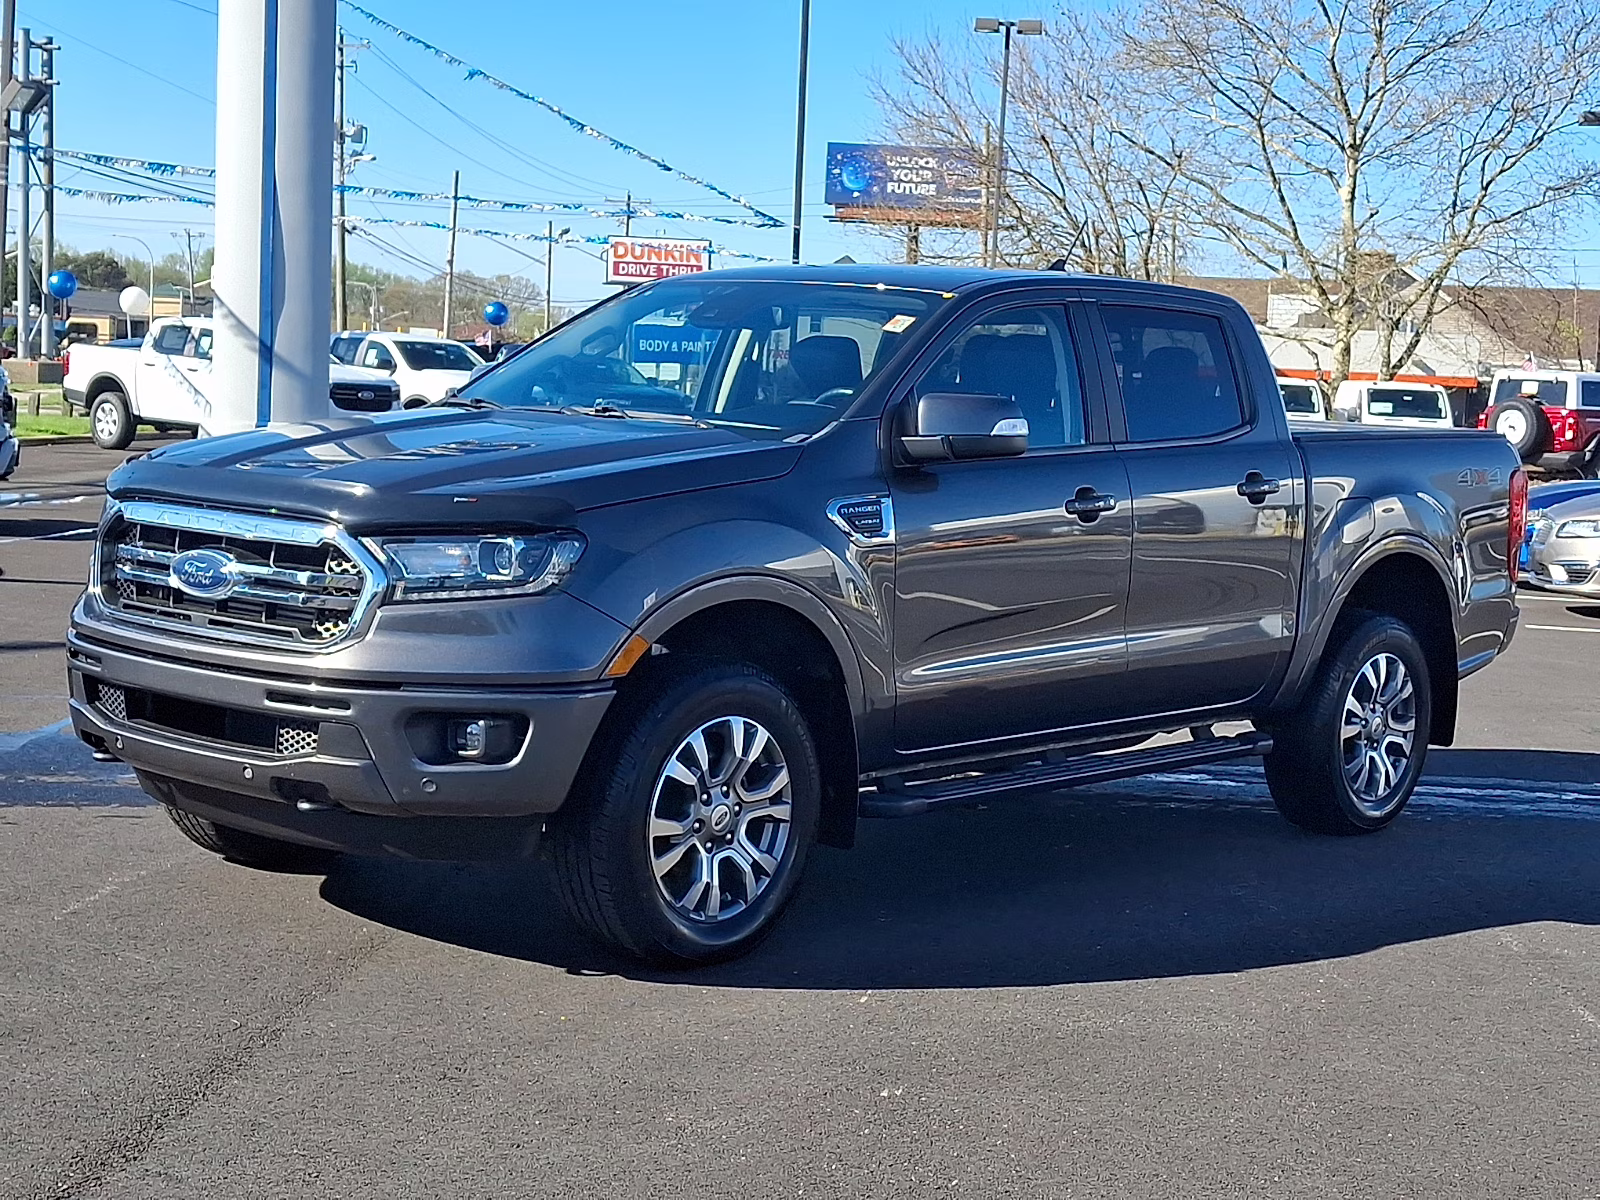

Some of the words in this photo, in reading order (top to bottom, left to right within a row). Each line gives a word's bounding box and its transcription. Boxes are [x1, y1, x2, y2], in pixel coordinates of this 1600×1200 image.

[890, 168, 933, 182] YOUR
[886, 181, 937, 196] FUTURE
[619, 262, 658, 276] DRIVE
[639, 339, 670, 352] BODY
[671, 342, 679, 352] &
[681, 341, 712, 353] PAINT
[180, 559, 216, 586] Ford
